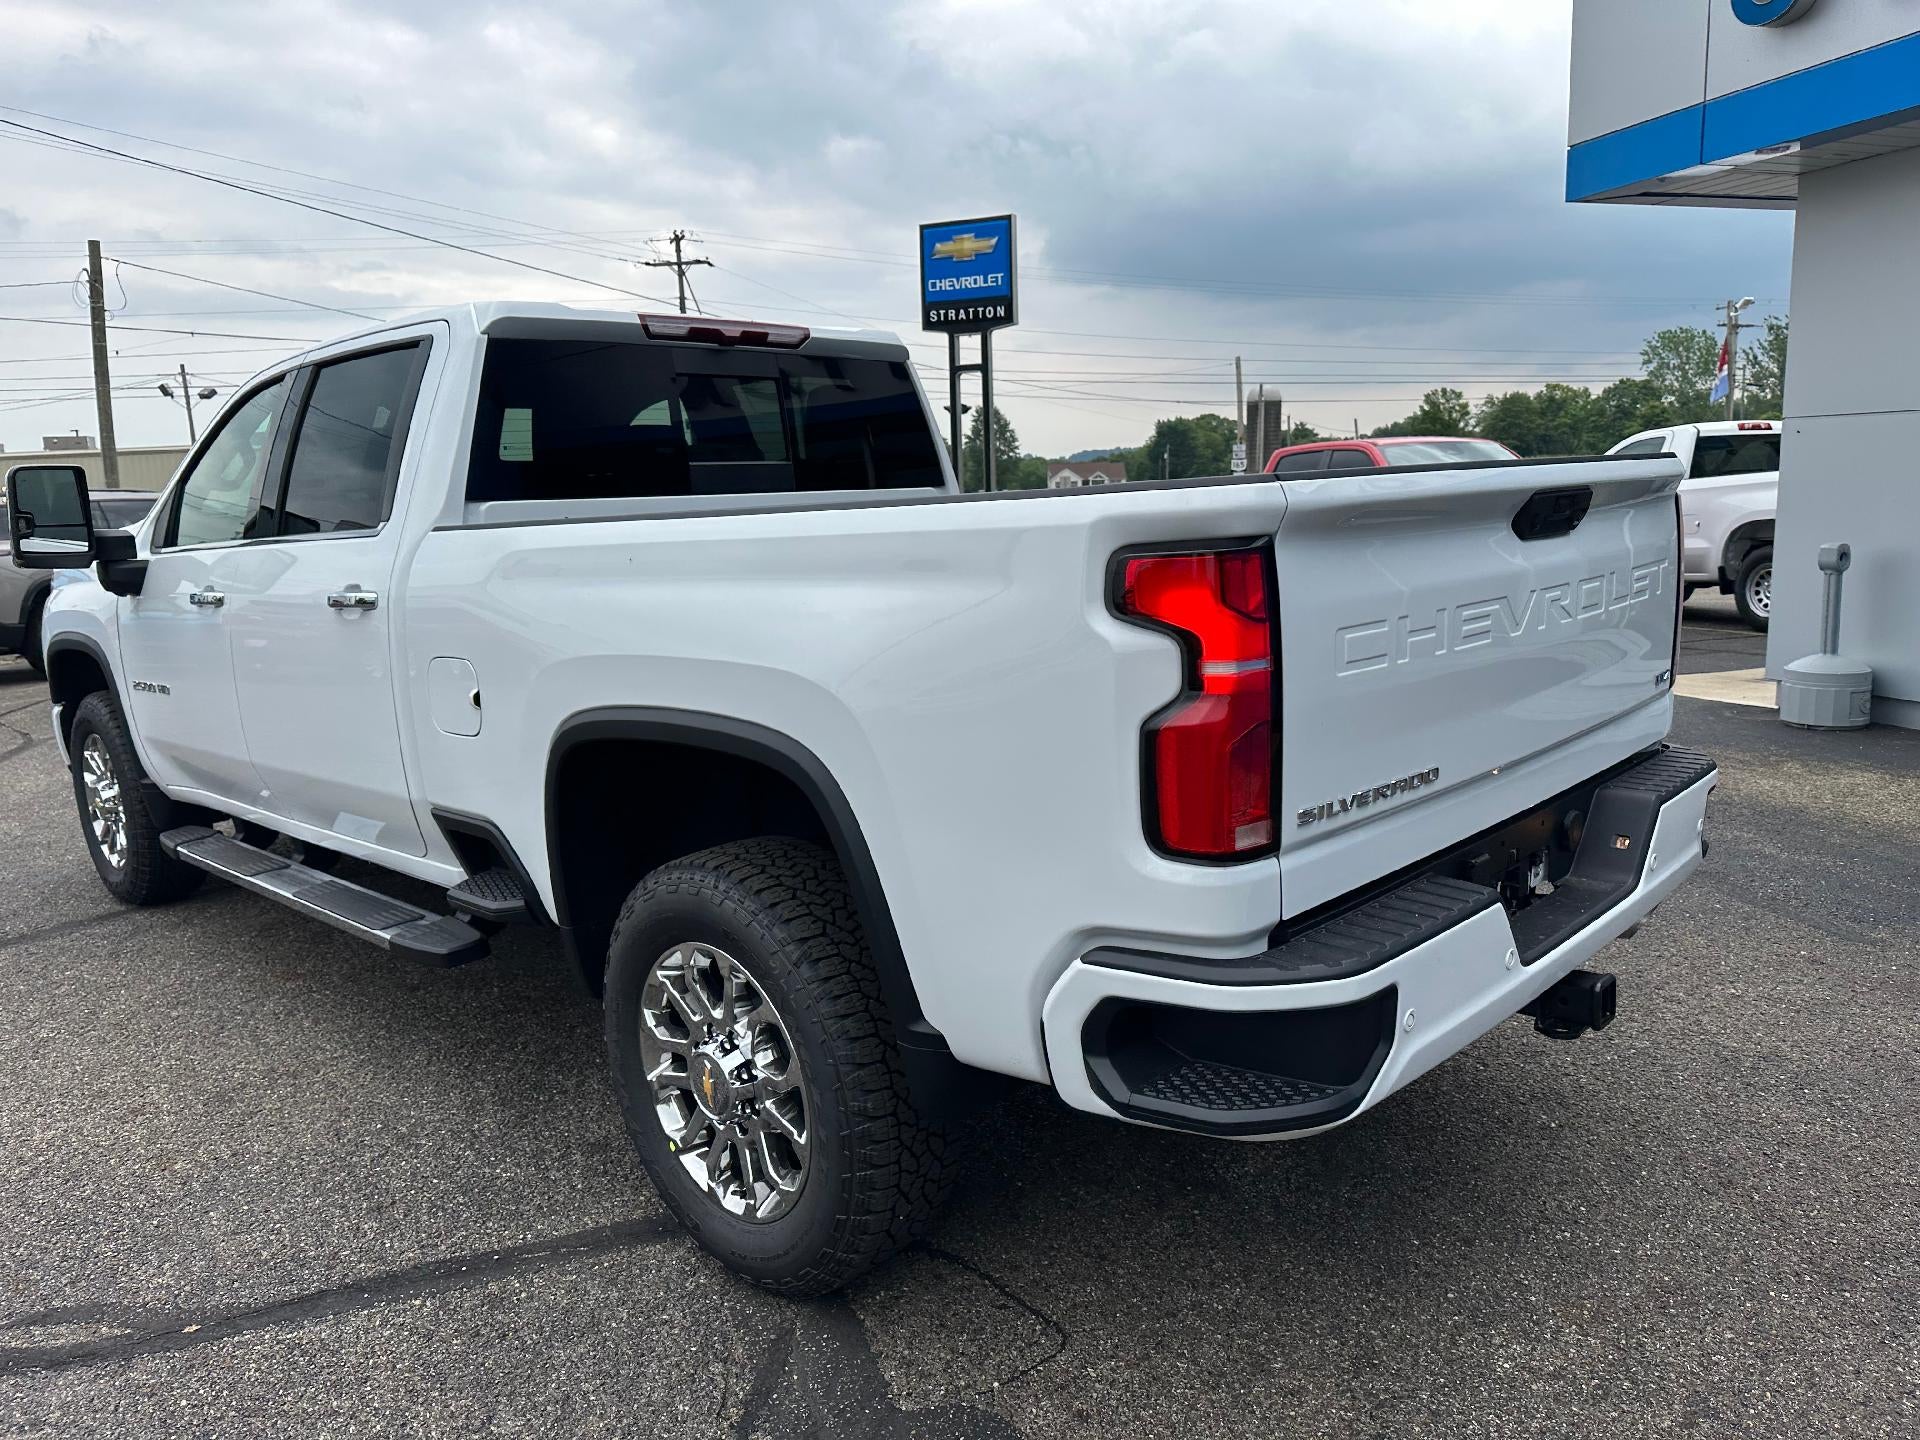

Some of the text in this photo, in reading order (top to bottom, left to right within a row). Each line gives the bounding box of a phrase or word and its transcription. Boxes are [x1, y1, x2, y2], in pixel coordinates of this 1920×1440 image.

[928, 273, 1004, 291] CHEVROLET
[929, 305, 1005, 322] STRATTON
[1335, 559, 1669, 677] CHEVROLET
[1297, 766, 1440, 824] SILVERADO
